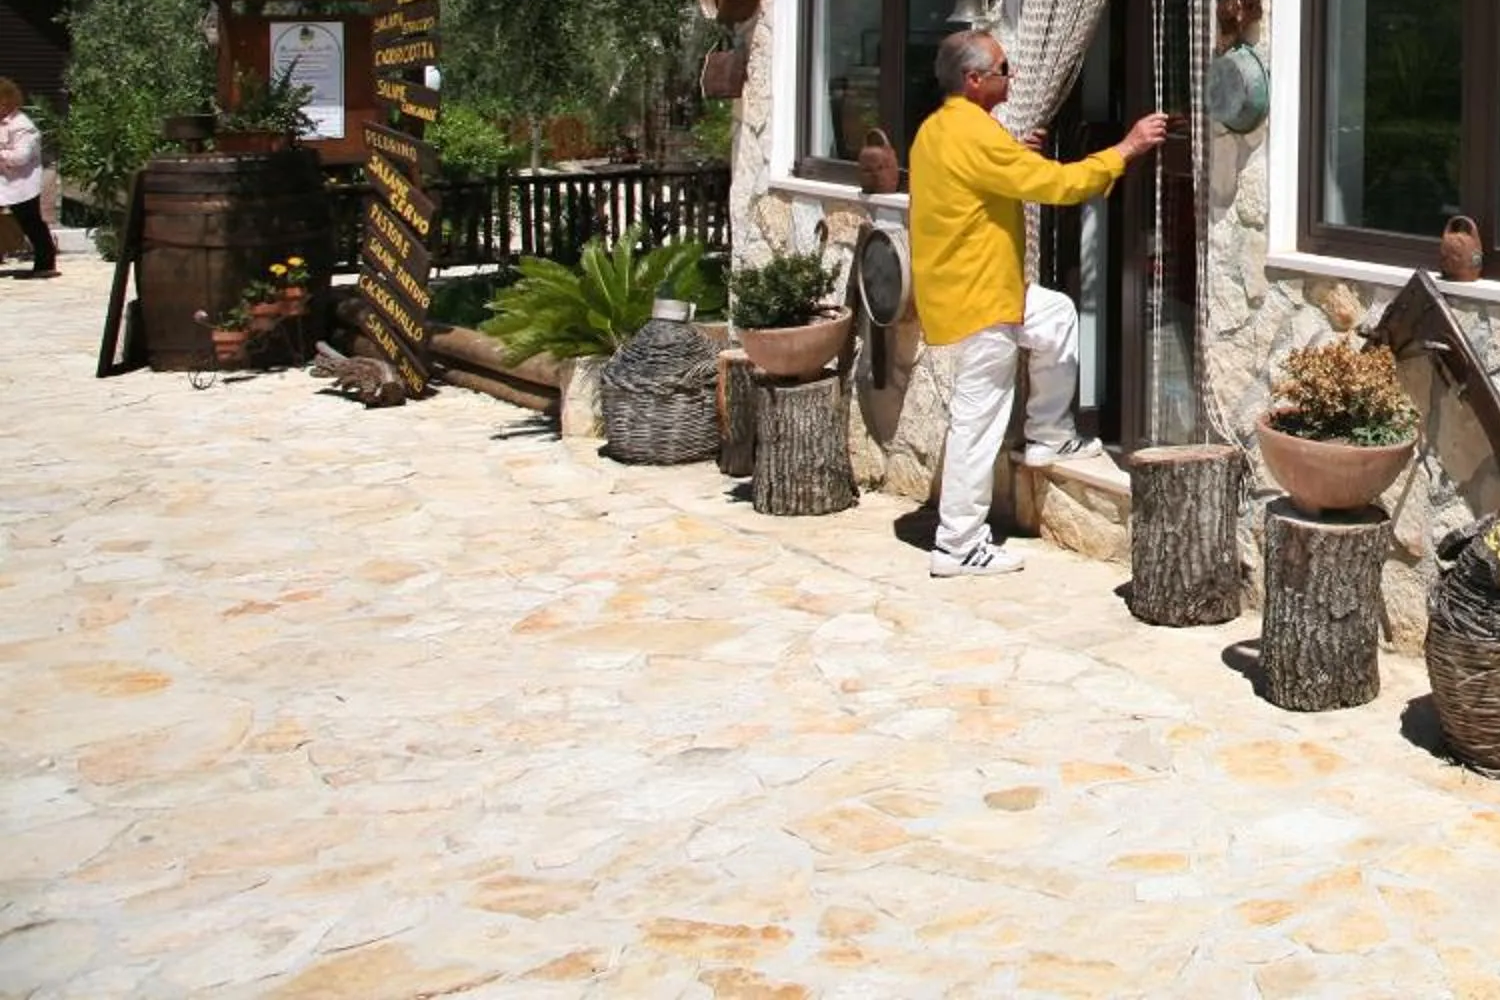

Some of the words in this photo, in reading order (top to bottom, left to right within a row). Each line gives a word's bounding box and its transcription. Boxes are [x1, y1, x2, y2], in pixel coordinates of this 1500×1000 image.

[365, 129, 417, 162] PECORINO
[368, 155, 409, 199] SALAME
[389, 193, 429, 235] CERVO
